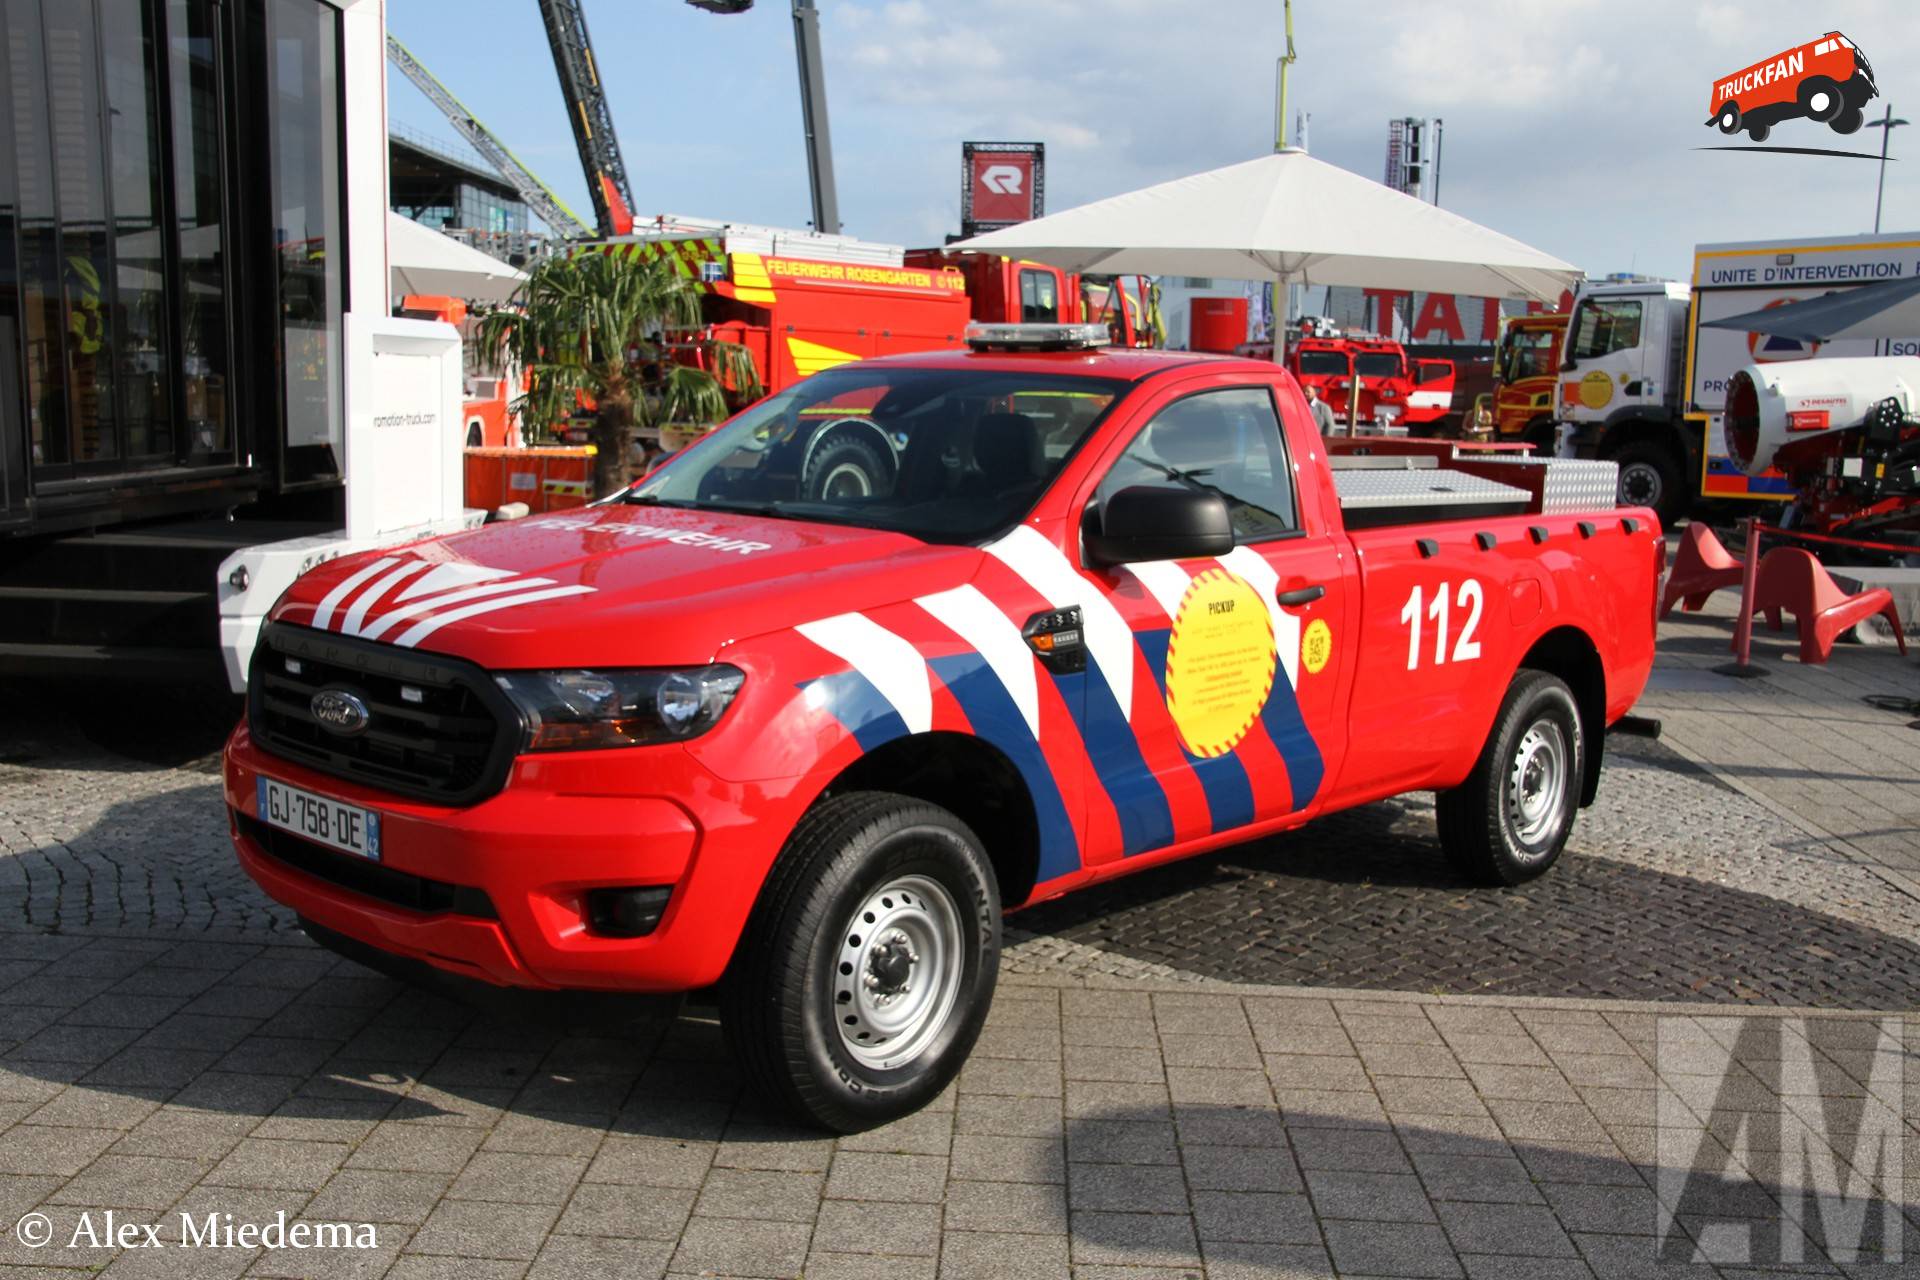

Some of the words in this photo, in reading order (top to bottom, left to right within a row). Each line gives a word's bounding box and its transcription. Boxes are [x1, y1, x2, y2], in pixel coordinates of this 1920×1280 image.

[766, 259, 845, 280] FEUERWEHR
[846, 267, 931, 288] ROSENGARTEN
[1711, 268, 1757, 283] UNITE
[1764, 262, 1902, 281] D'INTERVENTION
[1208, 600, 1235, 615] PICKUP
[1400, 578, 1484, 671] 112
